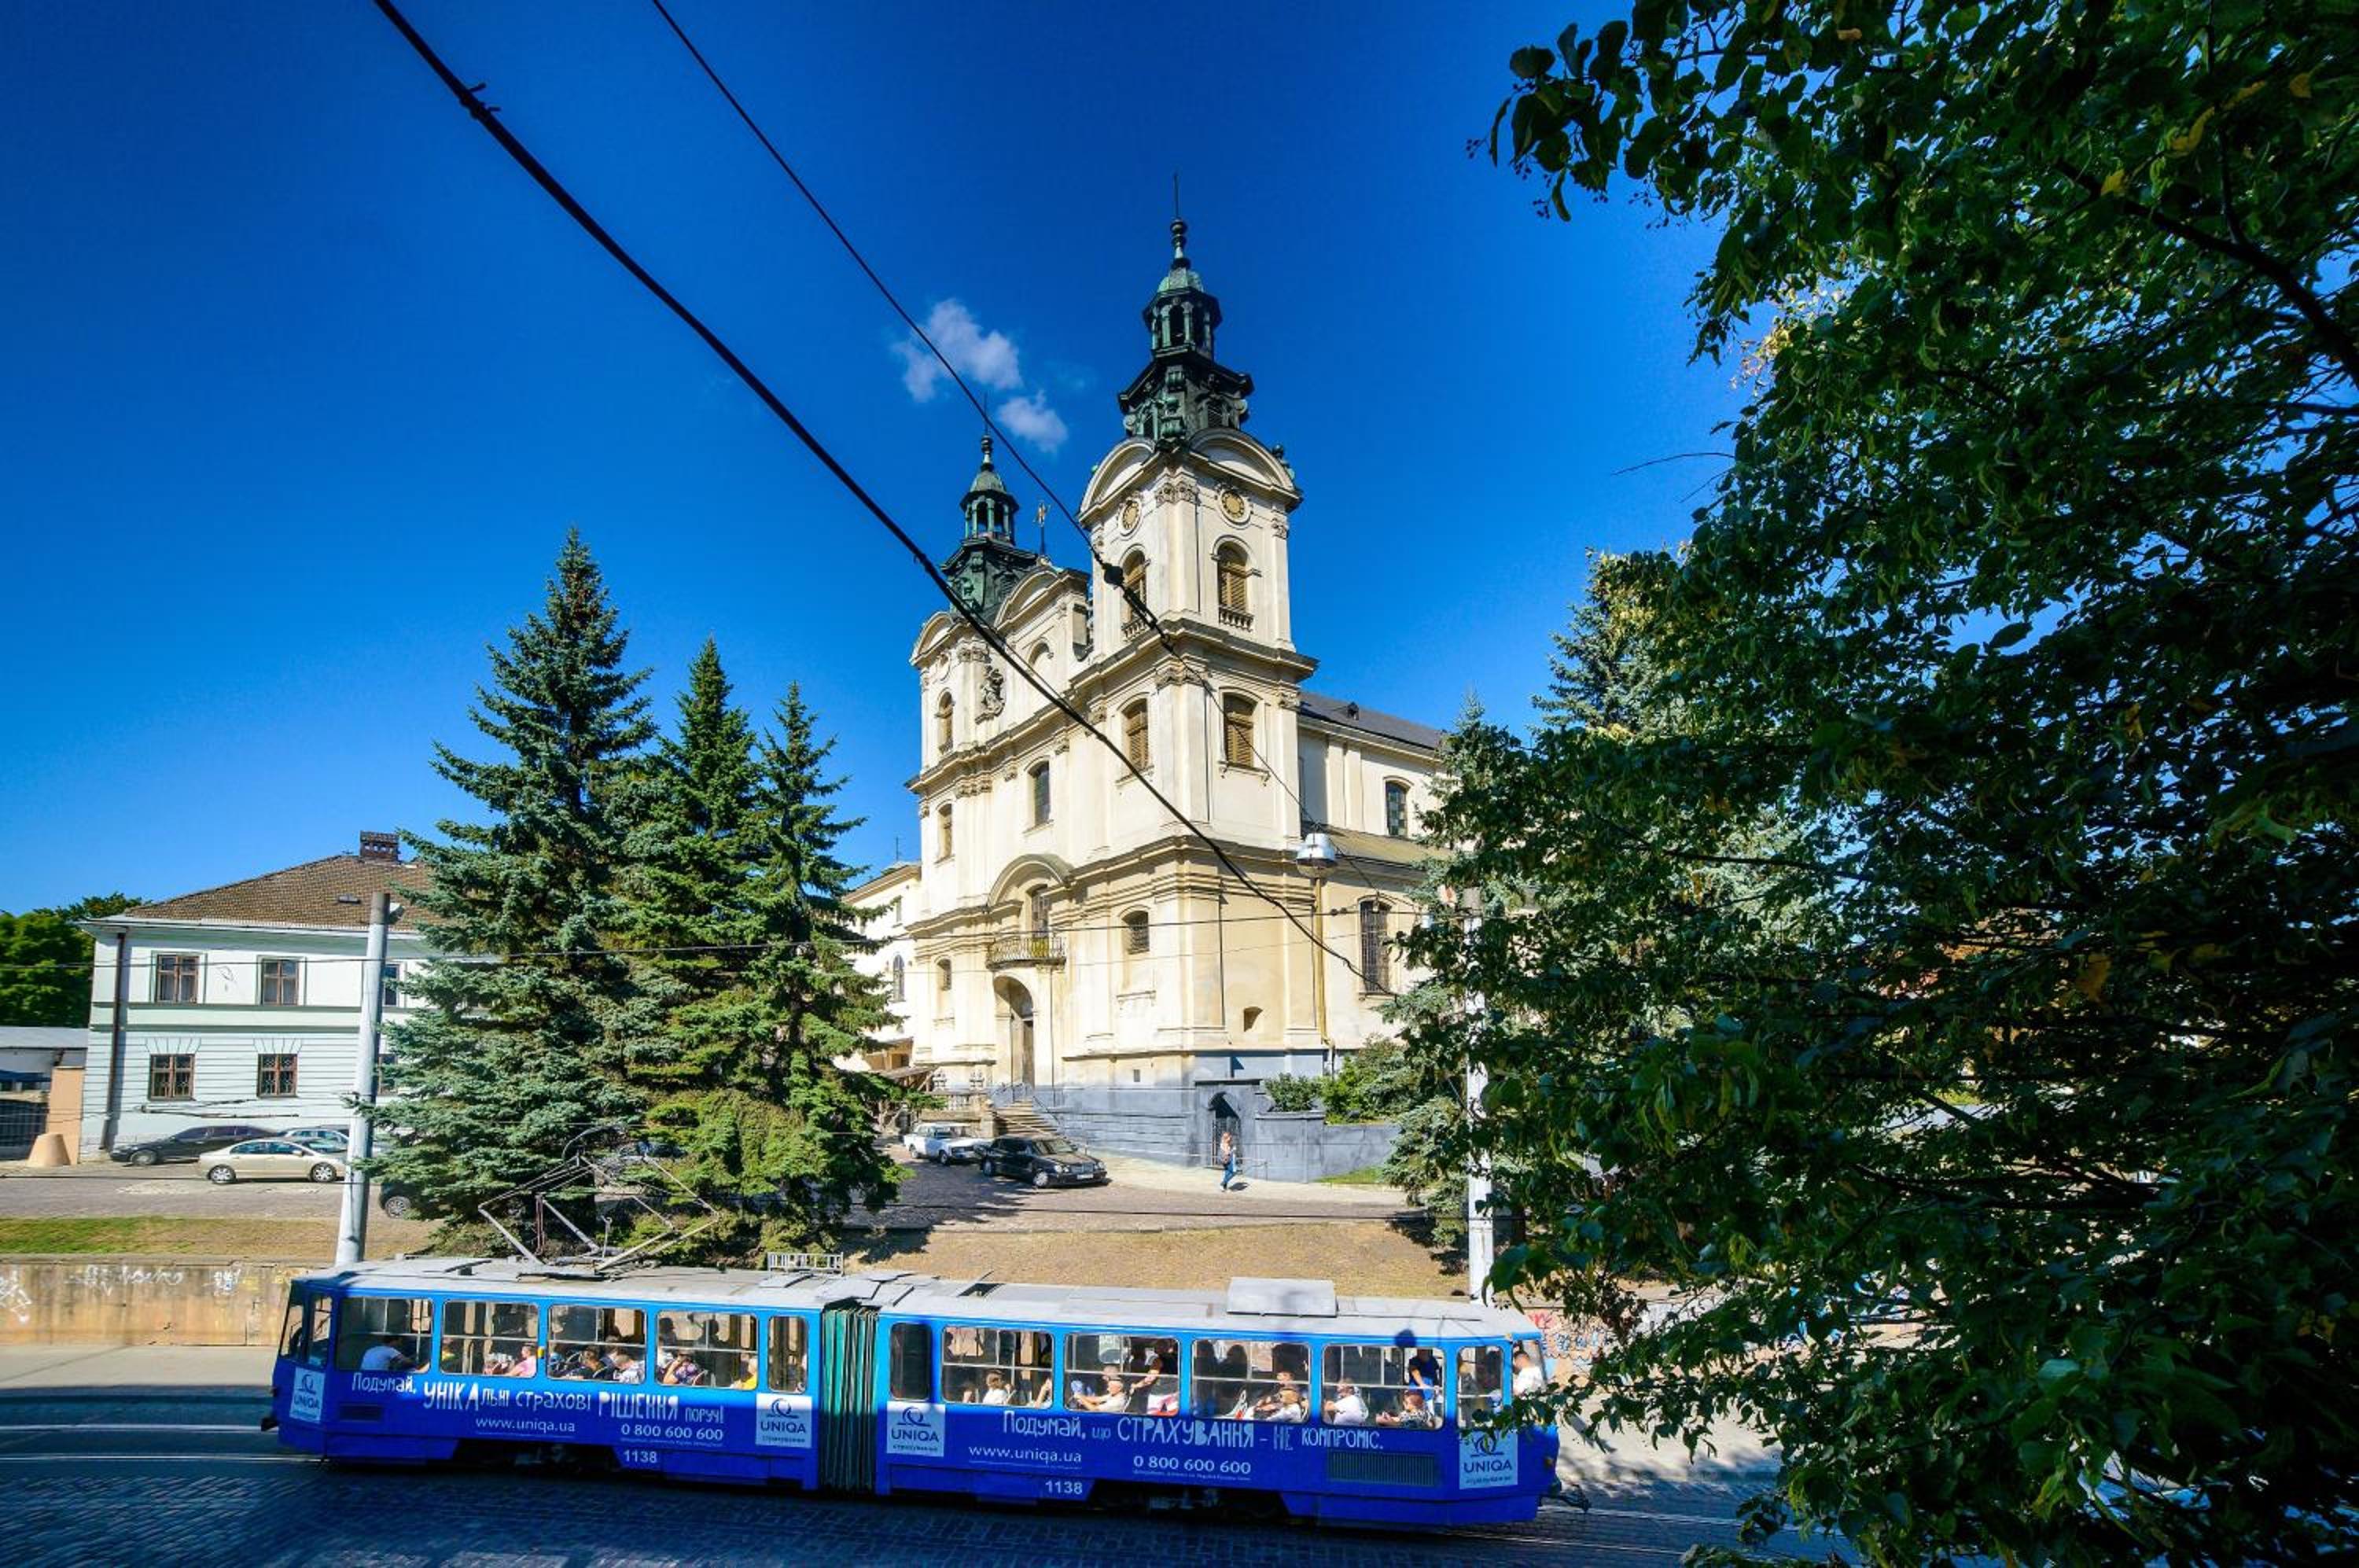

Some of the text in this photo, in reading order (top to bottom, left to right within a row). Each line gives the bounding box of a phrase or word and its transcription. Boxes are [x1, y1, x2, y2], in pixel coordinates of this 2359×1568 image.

[598, 1391, 679, 1420] РІШЕННЯ
[476, 1418, 576, 1433] www.uniqa.ua
[620, 1423, 723, 1441] 0 800 600 600
[760, 1421, 806, 1433] UNIQA
[1003, 1410, 1086, 1440] Подумай,
[1117, 1417, 1254, 1448] СТРАХУВАННЯ
[1273, 1425, 1294, 1451] НЕ
[892, 1428, 939, 1442] UNIQA
[624, 1449, 657, 1463] 1138
[969, 1446, 1082, 1464] www.uniqa.ua
[1133, 1456, 1251, 1474] 0 800 600 600
[1463, 1459, 1513, 1473] UNIQA
[1045, 1480, 1083, 1494] 1138
